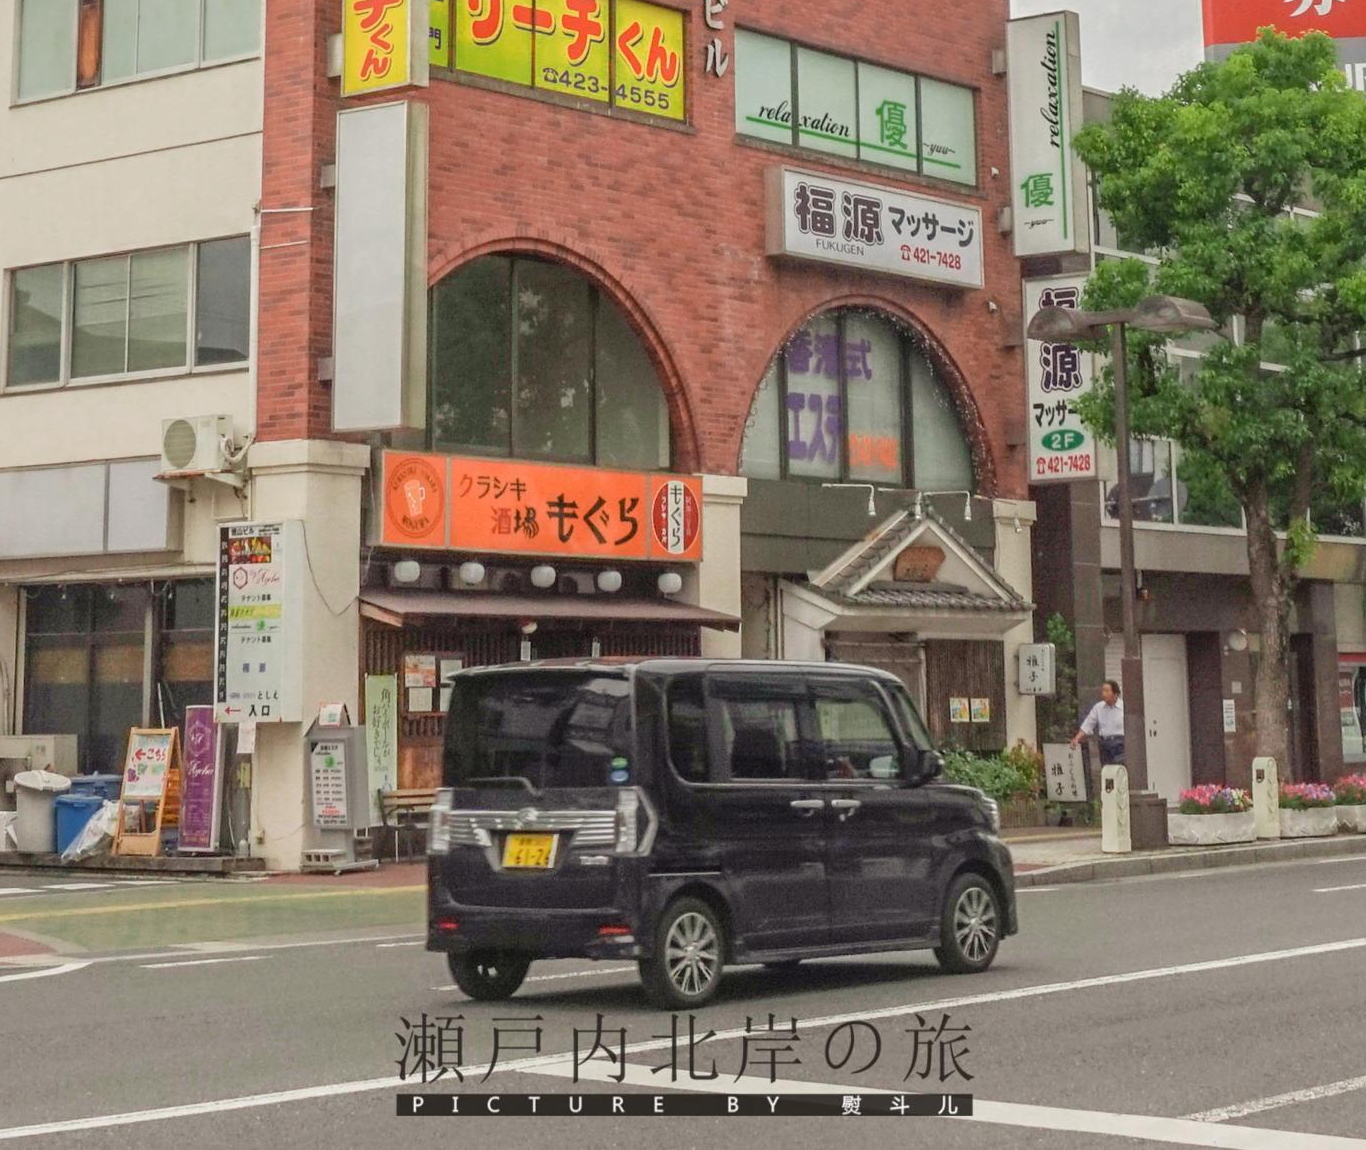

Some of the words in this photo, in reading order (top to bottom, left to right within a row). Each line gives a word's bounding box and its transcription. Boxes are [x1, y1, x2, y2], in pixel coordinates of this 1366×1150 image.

[557, 72, 670, 110] 423-4555
[1040, 30, 1060, 148] relaxation
[875, 100, 908, 150] 優
[1020, 173, 1054, 208] 優
[794, 182, 884, 246] 福源
[887, 206, 974, 247] マッサージ
[816, 238, 864, 256] FUKUGEN
[913, 249, 961, 270] 421-7428
[1051, 434, 1075, 448] 2F
[1047, 455, 1091, 473] 421-7428
[460, 474, 527, 501] クラシキ
[491, 505, 539, 539] 酒場
[546, 493, 639, 545] もぐら
[669, 485, 682, 547] もぐら
[248, 704, 270, 717] 入口
